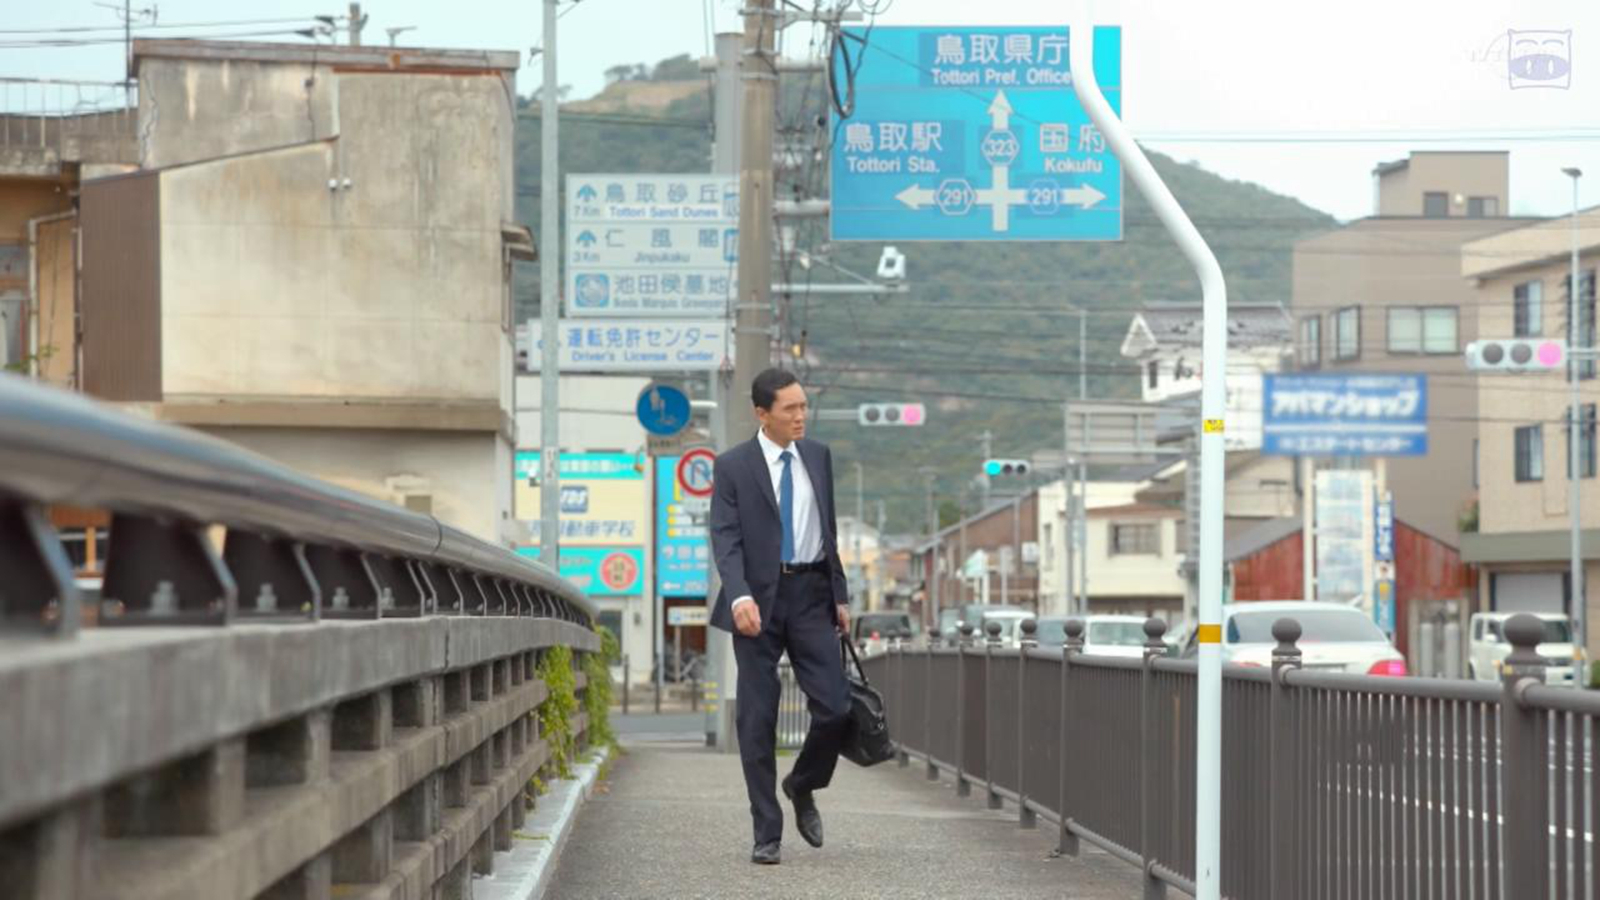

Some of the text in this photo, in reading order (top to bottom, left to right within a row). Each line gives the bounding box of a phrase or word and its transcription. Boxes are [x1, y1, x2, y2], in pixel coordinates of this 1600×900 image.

[934, 33, 1069, 66] 鳥取県庁
[932, 67, 1072, 85] Tottori Pref. Office
[844, 122, 943, 152] 鳥取駅
[985, 140, 1015, 156] 323
[848, 156, 941, 173] Tottori Sta.
[1045, 159, 1103, 173] Kokufu
[605, 183, 719, 203] 鳥取砂丘
[943, 189, 969, 205] 291
[1032, 189, 1059, 205] 291
[609, 206, 718, 218] Tottori Sand Dunes
[568, 327, 720, 347] 運転免許センター
[571, 350, 715, 362] Driver's License Center
